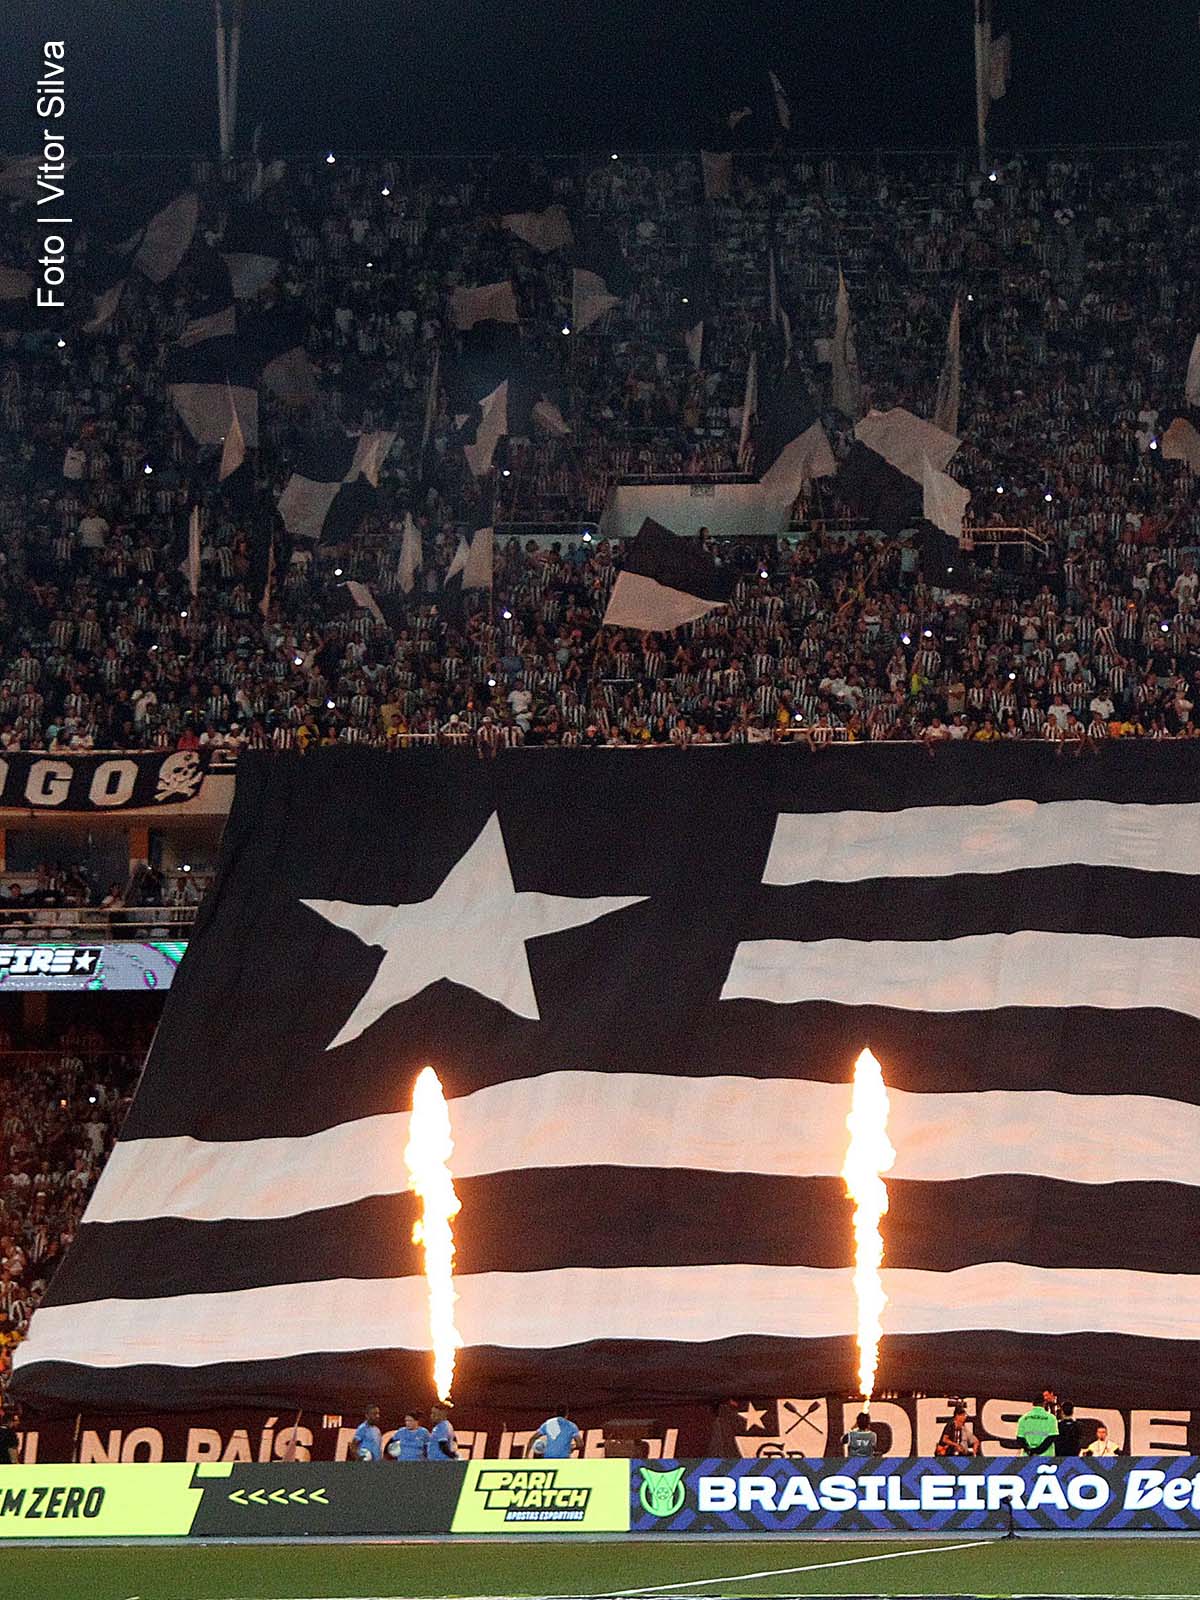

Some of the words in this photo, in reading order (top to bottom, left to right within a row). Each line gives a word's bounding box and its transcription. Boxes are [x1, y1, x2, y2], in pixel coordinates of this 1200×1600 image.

[0, 759, 139, 806] GO
[80, 1427, 164, 1463] NO
[186, 1416, 314, 1463] PAÍS
[479, 1472, 555, 1490] PARI
[698, 1464, 1110, 1511] BRASILEIRÃO
[0, 1486, 106, 1519] MZERO
[487, 1489, 589, 1508] MATCH
[506, 1510, 540, 1520] APOSTAS
